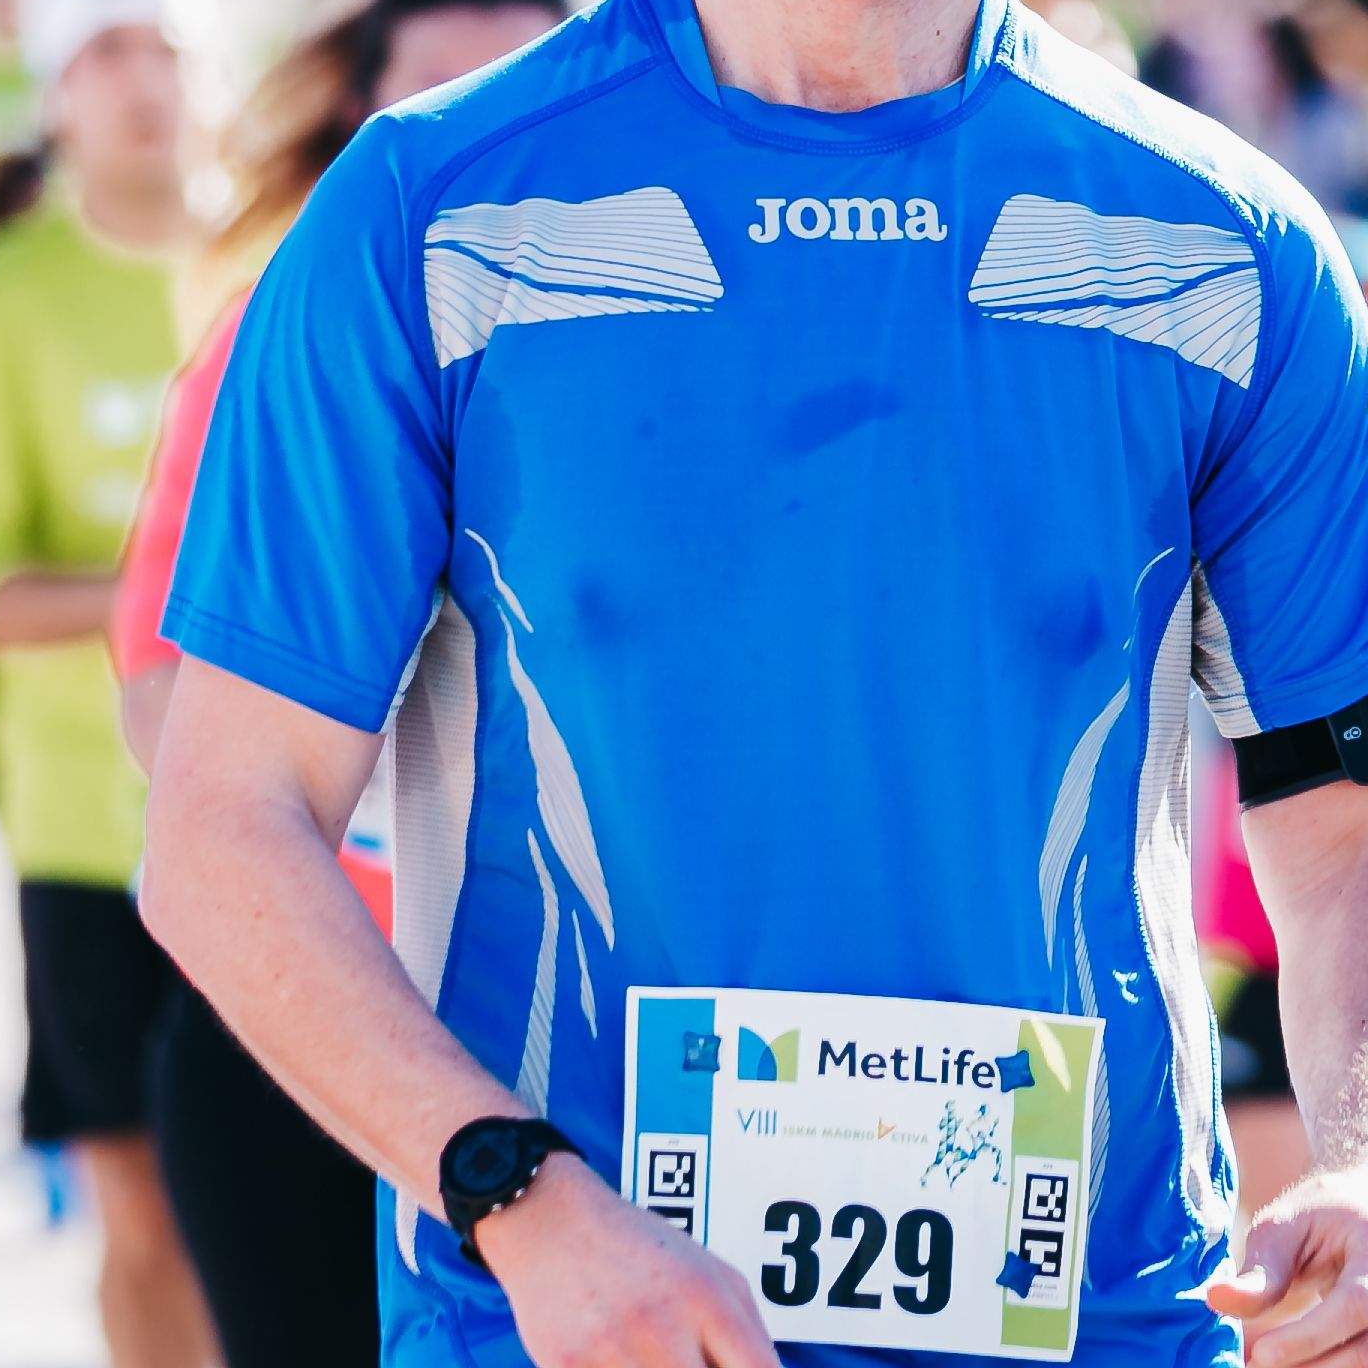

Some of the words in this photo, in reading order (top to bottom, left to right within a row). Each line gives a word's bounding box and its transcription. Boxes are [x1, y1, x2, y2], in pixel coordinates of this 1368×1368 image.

[817, 1039, 996, 1089] MetLife
[737, 1109, 777, 1135] VIII
[761, 1200, 954, 1315] 329
